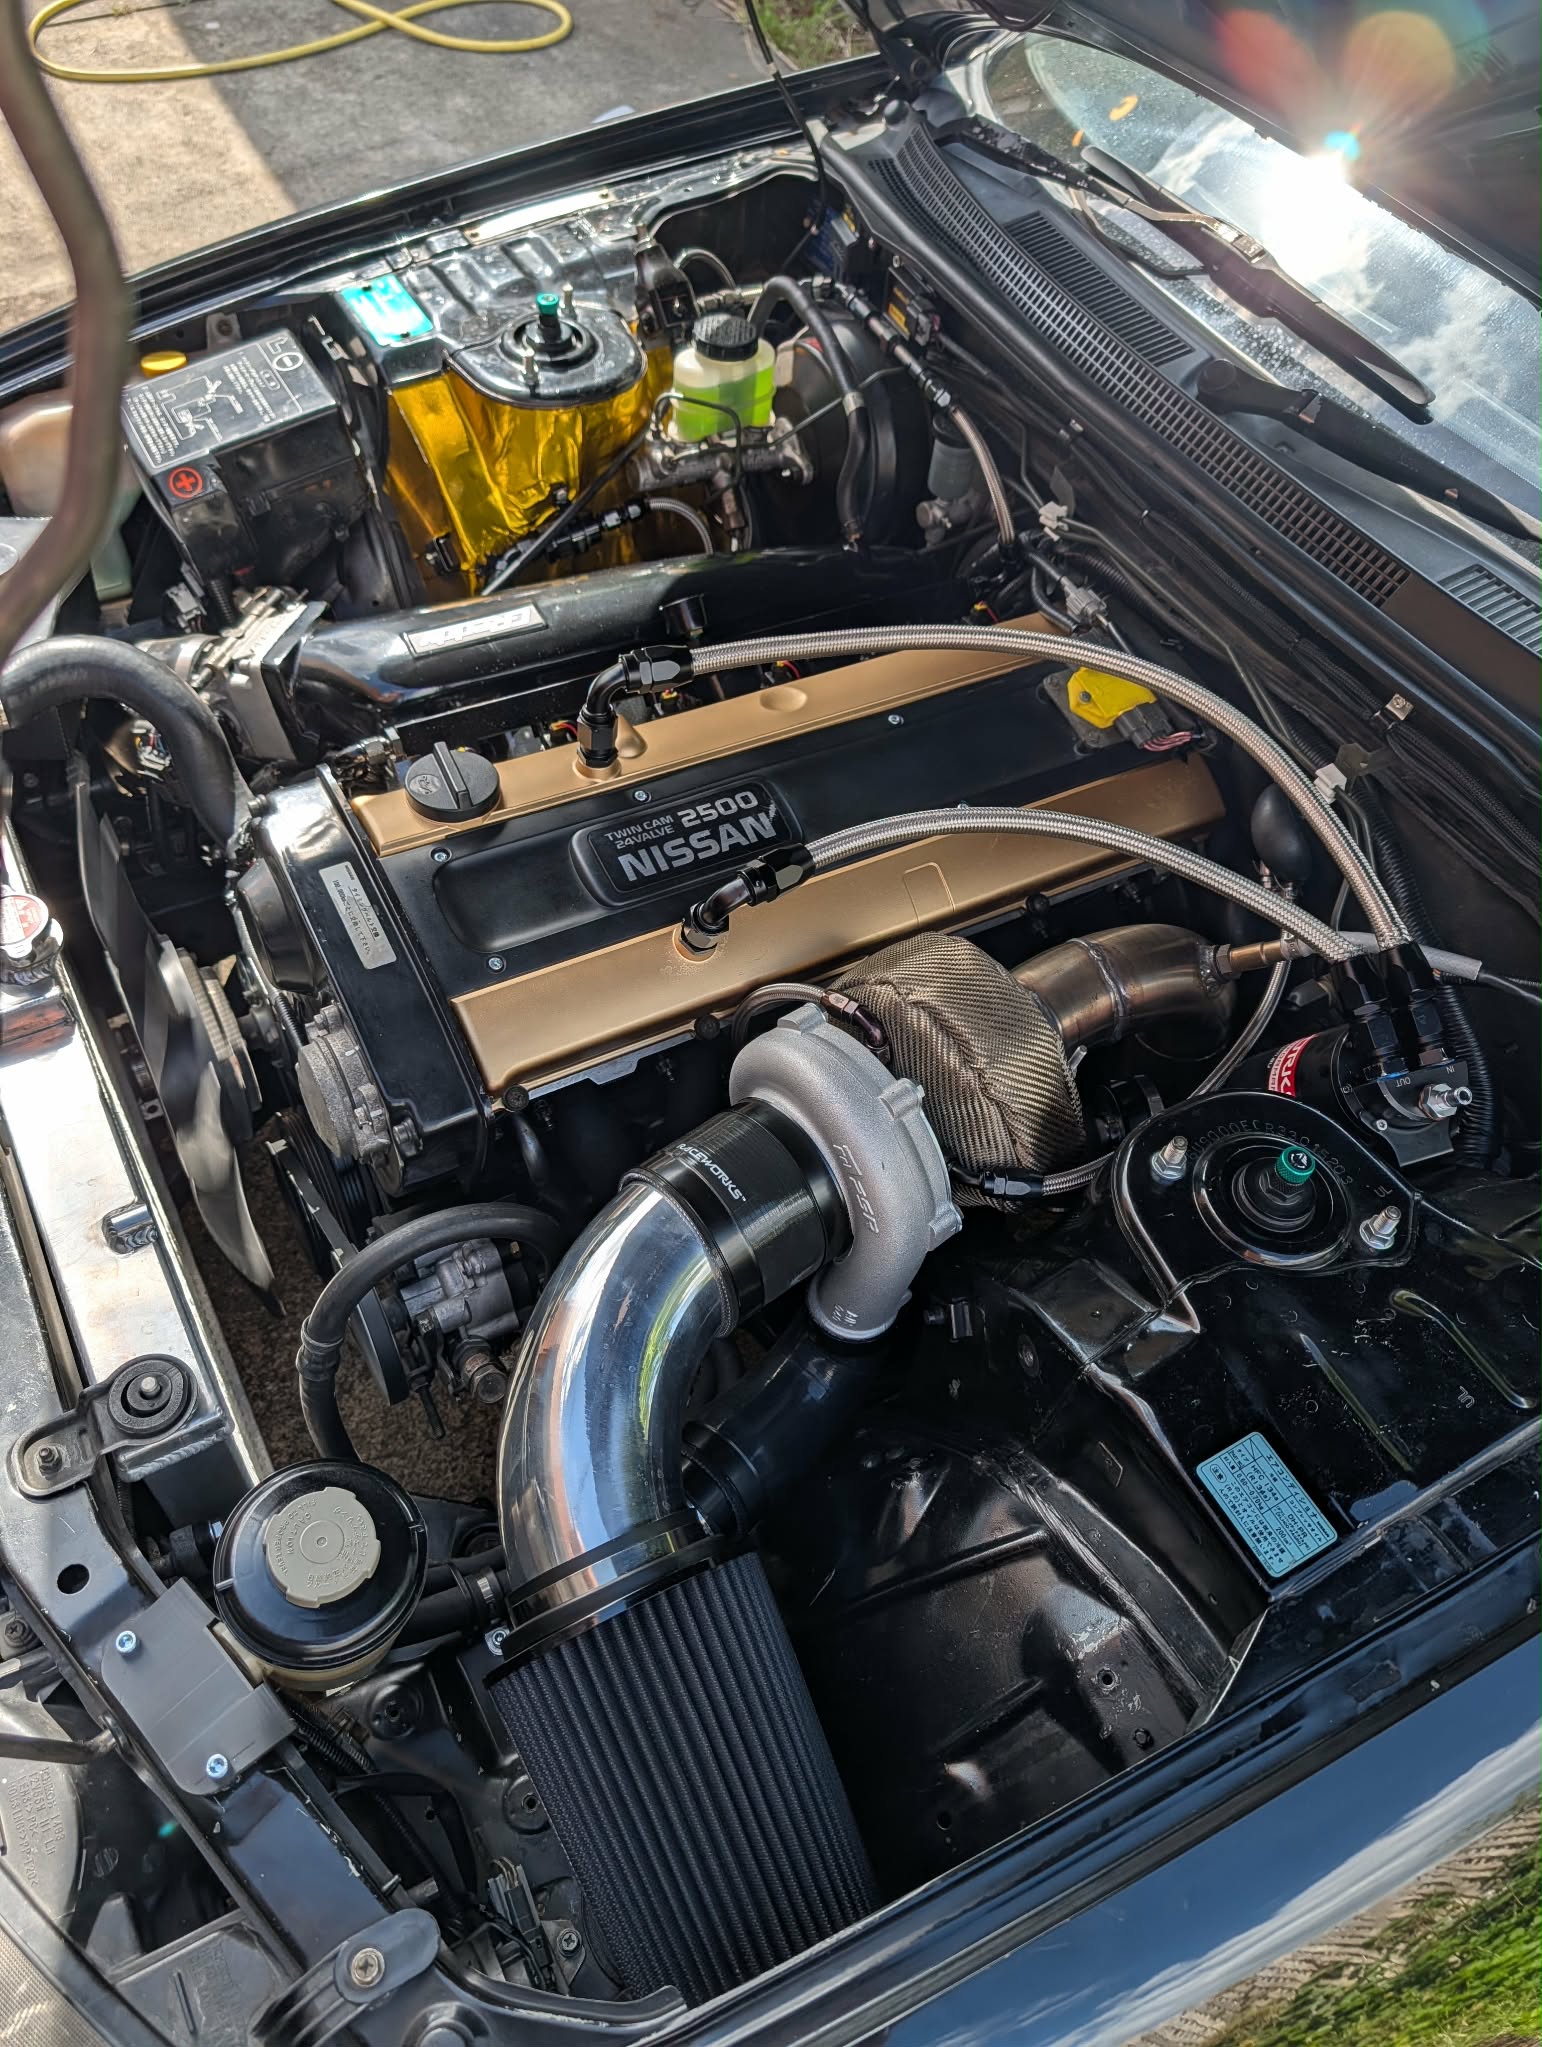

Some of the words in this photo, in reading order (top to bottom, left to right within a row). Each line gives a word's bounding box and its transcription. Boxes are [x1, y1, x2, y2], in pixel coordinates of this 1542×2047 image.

[604, 823, 642, 841] TWIN
[643, 814, 673, 830] CAM
[677, 790, 758, 828] 2500
[615, 824, 674, 849] 24VALVE
[617, 811, 776, 881] NISSAN
[1395, 1077, 1410, 1086] OUT
[1446, 1065, 1454, 1073] IN
[1250, 1464, 1264, 1480] HFC
[1263, 1483, 1279, 1501] 134a
